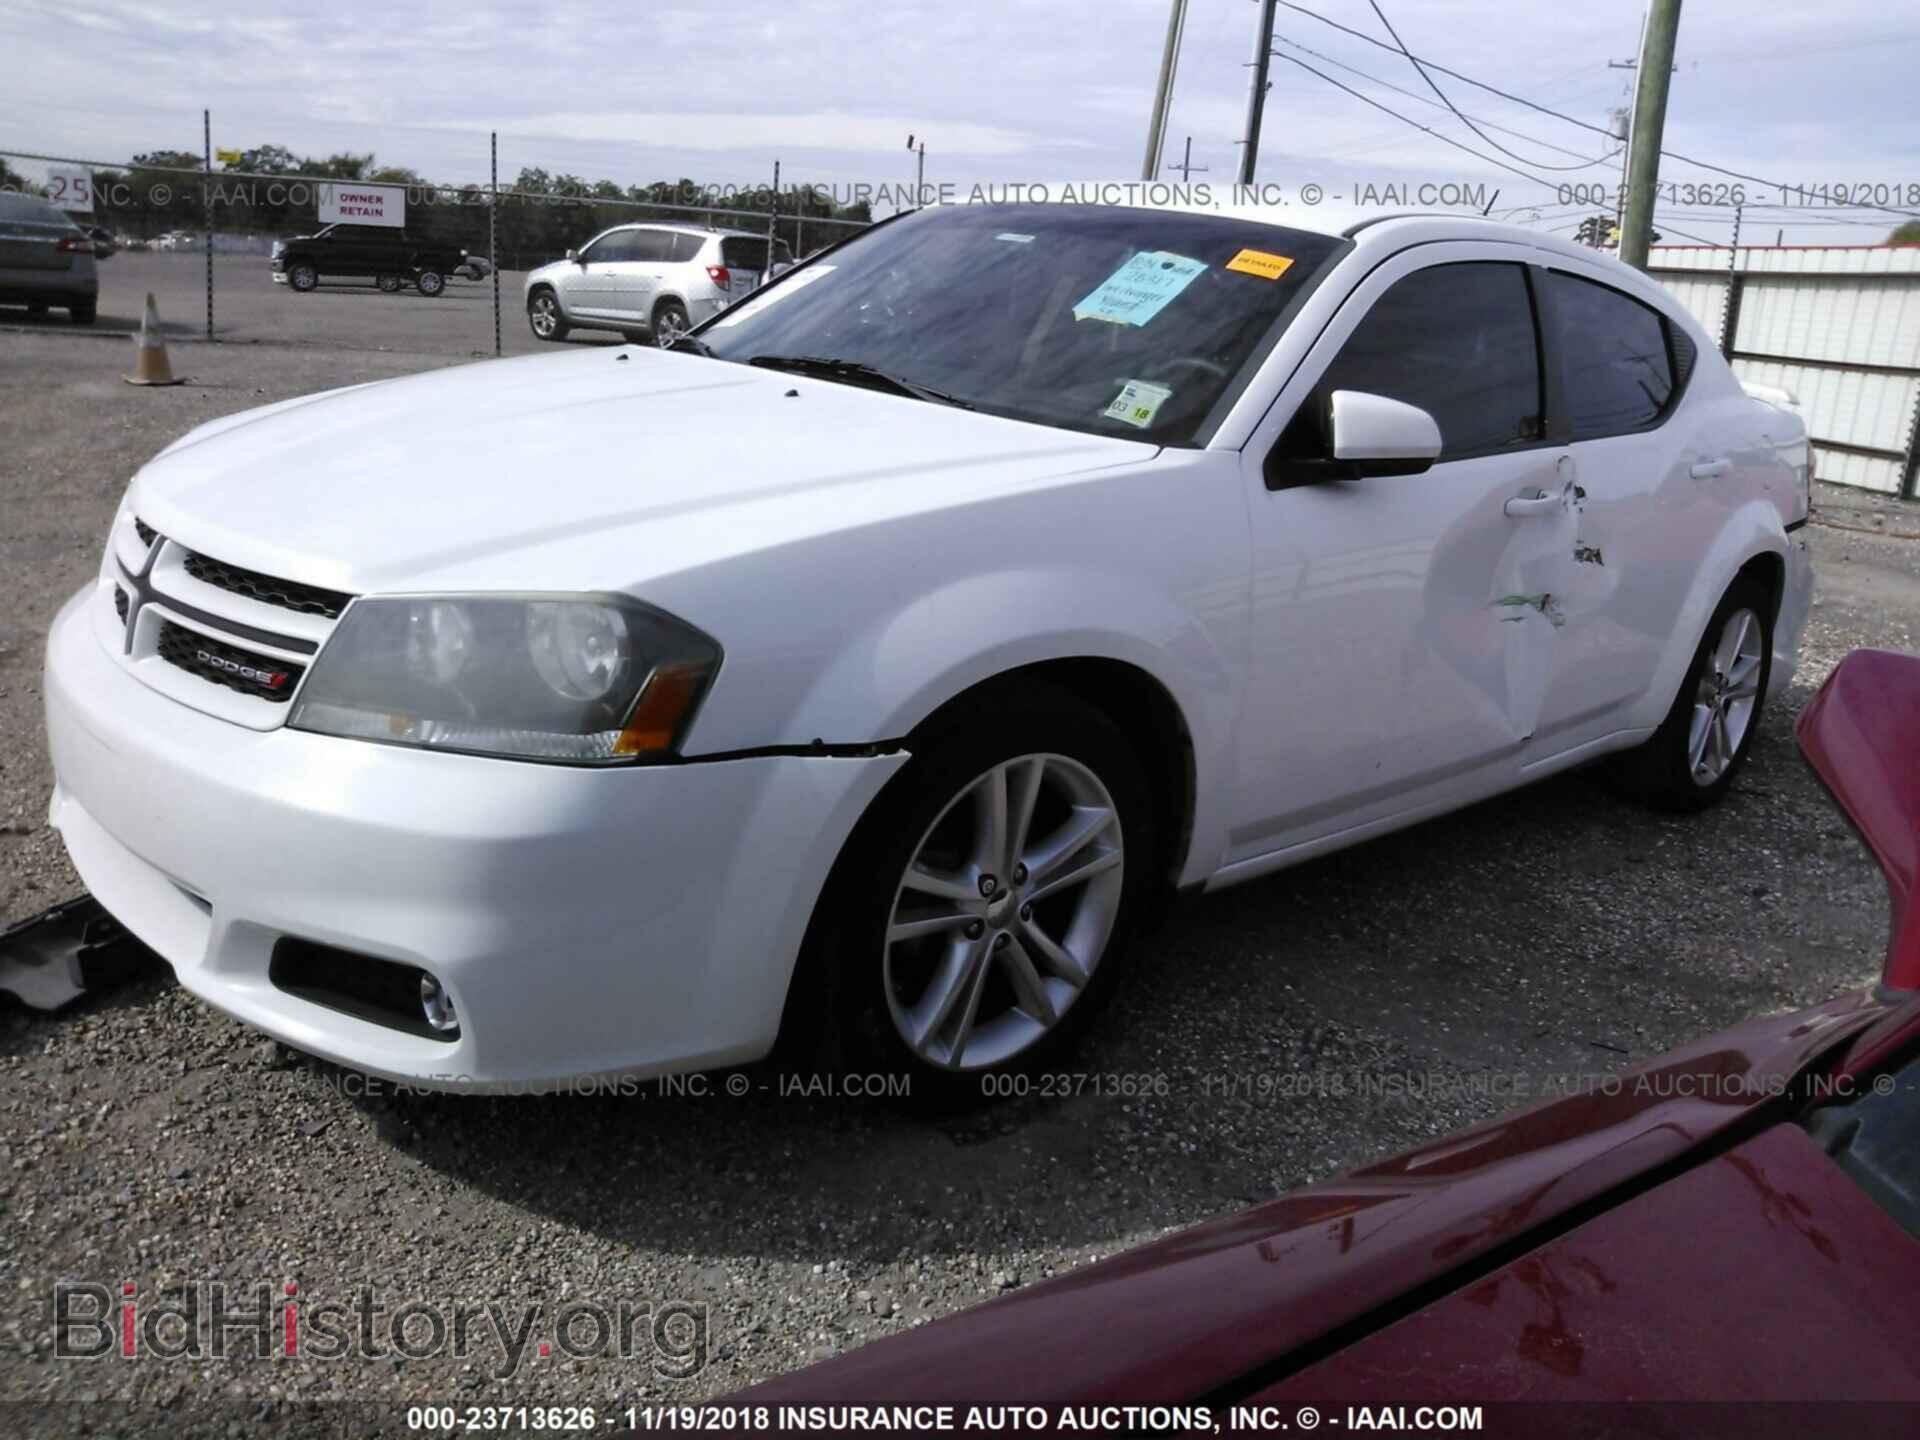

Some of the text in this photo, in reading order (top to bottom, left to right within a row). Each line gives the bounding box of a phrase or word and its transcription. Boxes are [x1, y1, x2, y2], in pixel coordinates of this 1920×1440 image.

[52, 176, 89, 201] 25
[340, 193, 384, 205] OWNER
[340, 206, 384, 217] RETAIN
[1112, 400, 1150, 419] 03 18
[197, 650, 272, 684] DODGE
